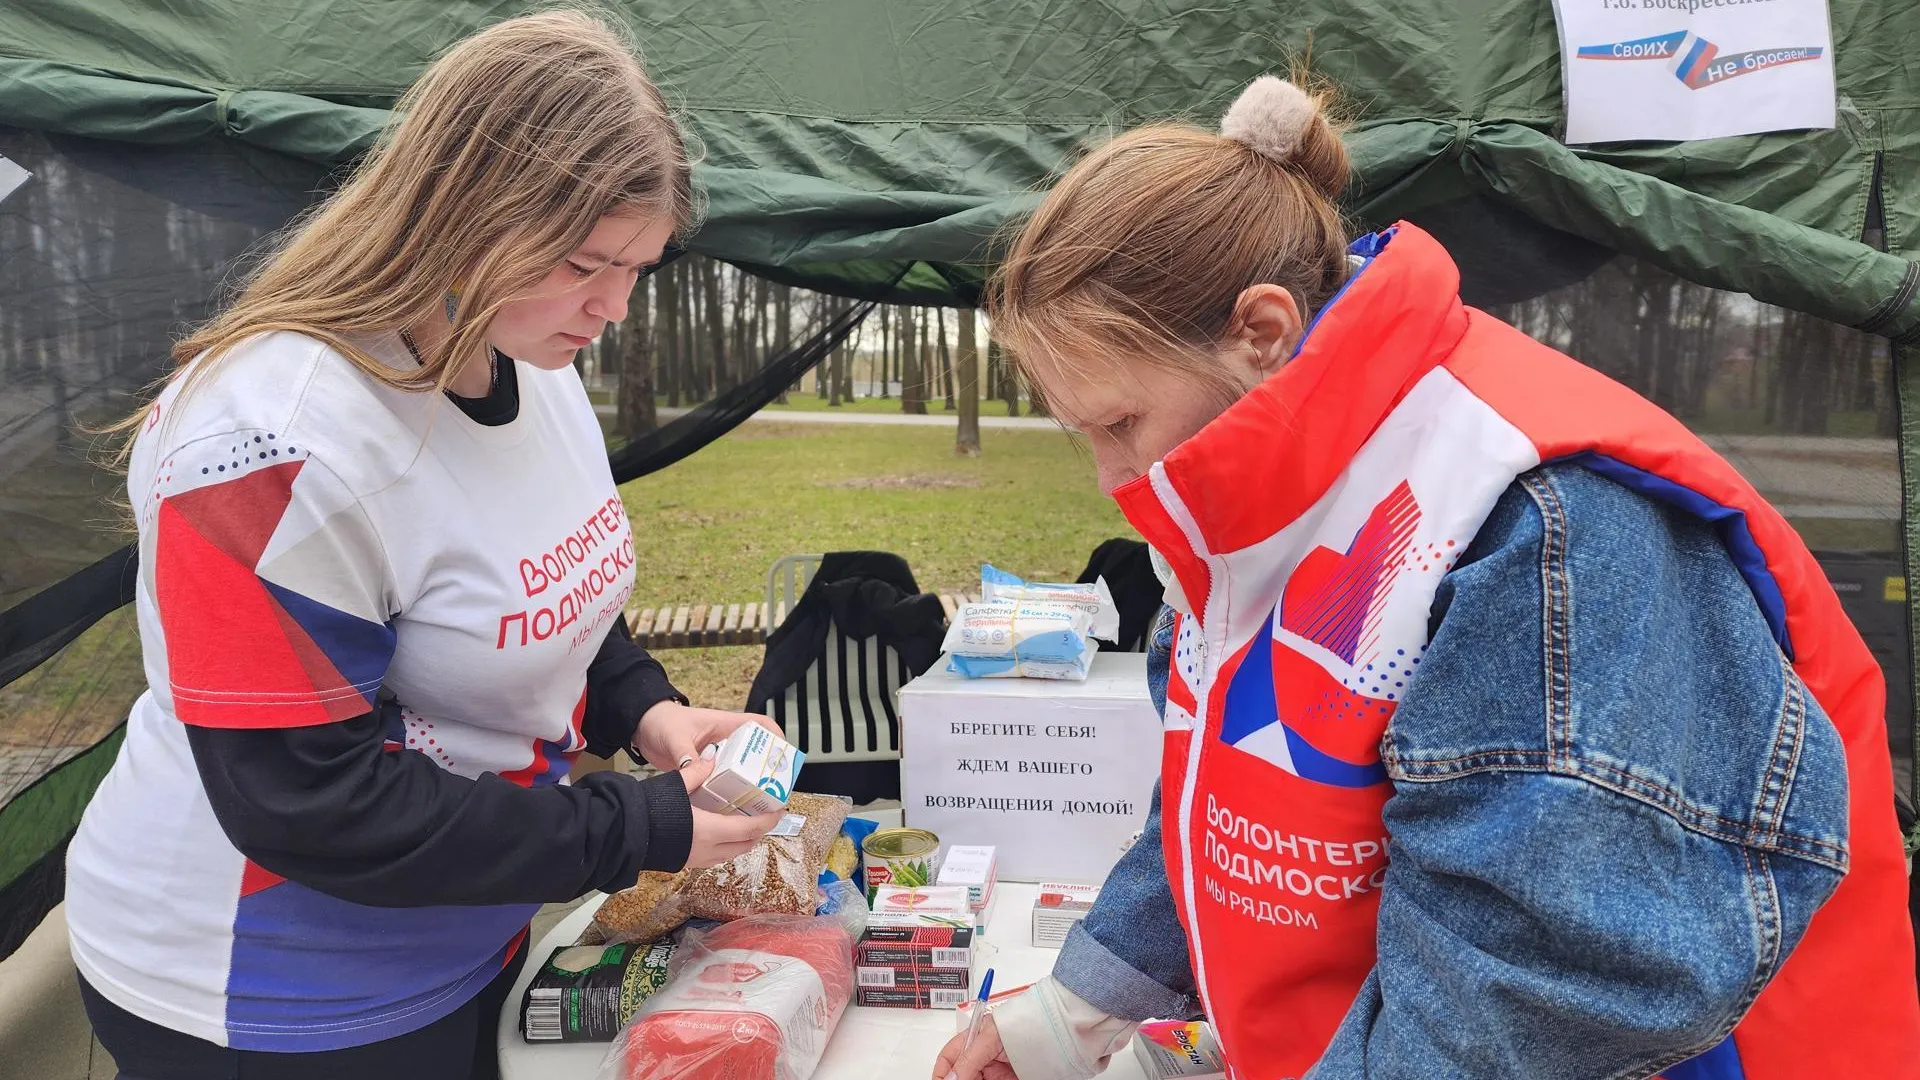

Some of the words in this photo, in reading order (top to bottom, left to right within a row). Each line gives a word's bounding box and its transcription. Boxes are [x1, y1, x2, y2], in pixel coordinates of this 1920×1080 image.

[1643, 0, 1778, 14] Воскрес
[1612, 40, 1669, 58] Своих
[1707, 62, 1738, 82] не
[1744, 47, 1809, 70] бросаем!
[496, 530, 634, 649] ПОДМОСКО
[965, 607, 1016, 616] Салфетки
[950, 722, 1037, 737] БЕРЕГИТЕ
[1045, 725, 1097, 739] СЕБЯ!
[957, 758, 1009, 775] ЖДЕМ
[1018, 760, 1093, 776] ВАШЕГО
[925, 795, 1054, 813] ВОЗВРАЩЕНИЯ
[1062, 799, 1134, 816] ДОМОЙ!
[1205, 830, 1389, 901] ПОДМОСКО
[1205, 874, 1226, 906] МЫ
[1230, 891, 1319, 930] РЯДОМ
[1173, 1029, 1204, 1066] БРУСТАН
